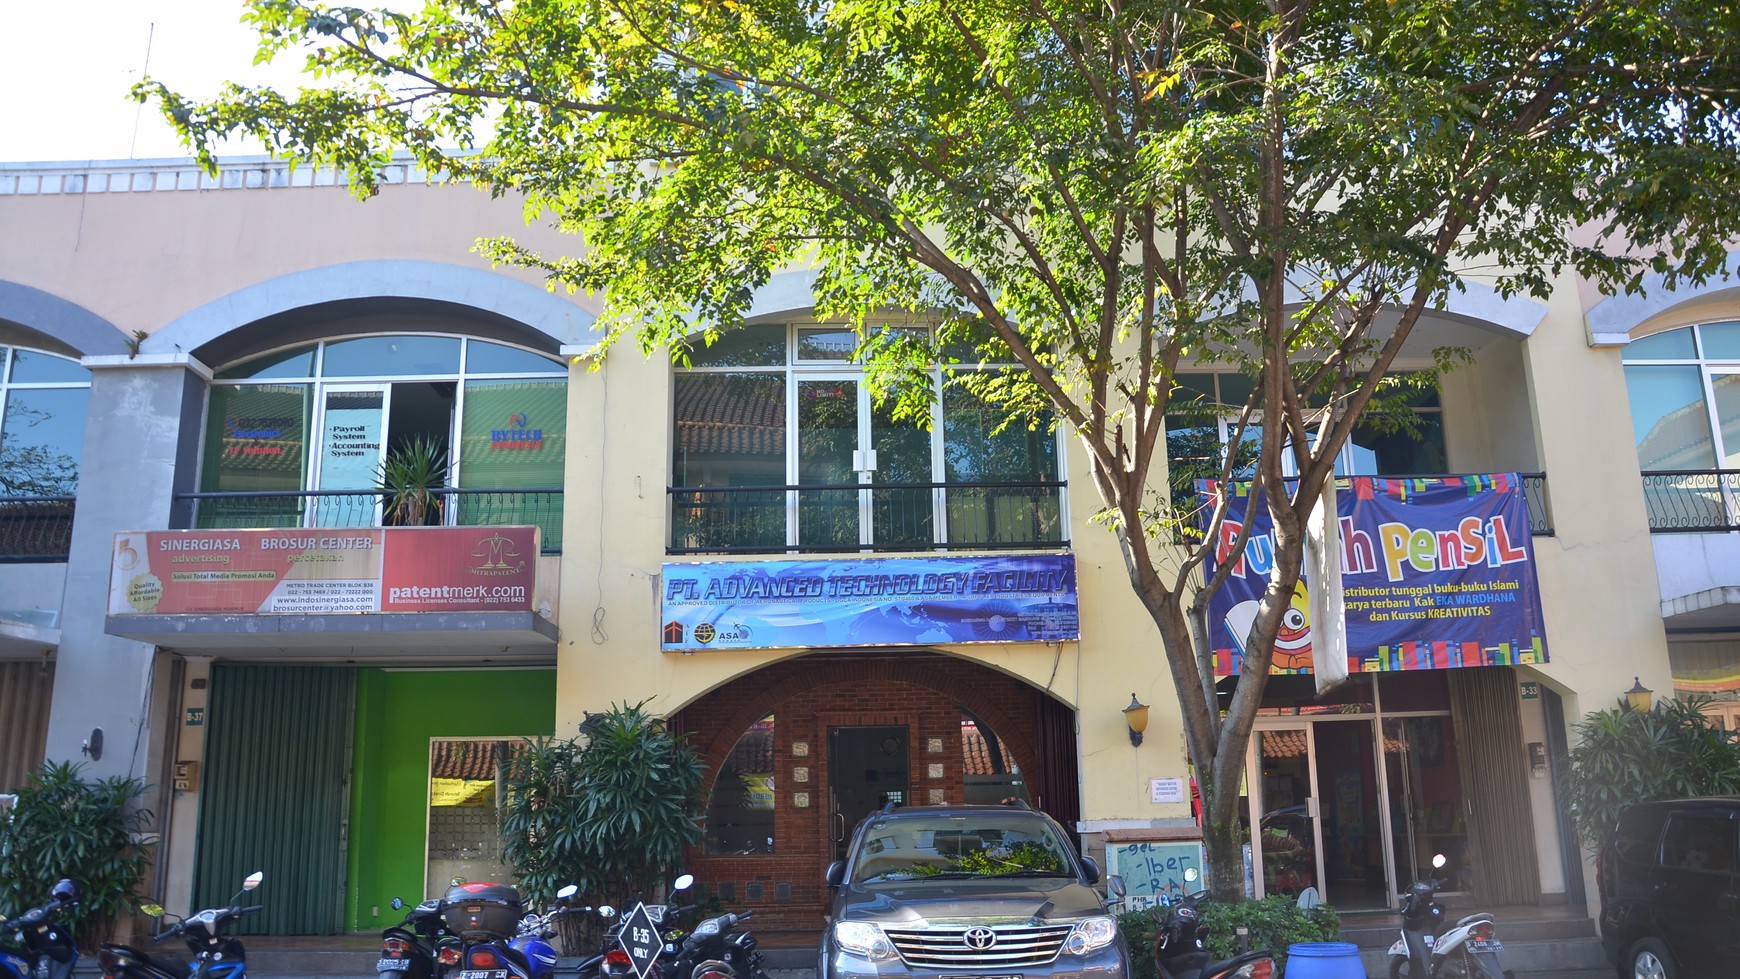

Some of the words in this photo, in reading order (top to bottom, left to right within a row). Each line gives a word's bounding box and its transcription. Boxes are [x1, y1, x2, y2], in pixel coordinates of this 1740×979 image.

[333, 425, 365, 433] Payroll
[331, 442, 380, 450] Accounting
[160, 539, 241, 551] SINERGIASA
[261, 538, 317, 551] BROSUR
[319, 537, 374, 551] CENTER
[1212, 515, 1377, 579] Ruh
[171, 553, 231, 565] advertising
[230, 572, 257, 580] Promosi
[134, 582, 155, 590] Quality
[667, 579, 698, 599] PT.
[704, 576, 823, 598] ADVANCED
[827, 574, 969, 596] TECHNOLOGY
[972, 570, 1068, 593] FACILITY
[1341, 584, 1390, 597] istributor
[1391, 584, 1433, 598] tunggal
[1434, 580, 1487, 594] buku-buku
[1489, 579, 1520, 591] Islami
[276, 596, 373, 604] www.indosinergiasa.com
[389, 585, 525, 603] patentmerk.com
[1371, 598, 1411, 609] terbaru
[1414, 597, 1435, 607] Kak
[1436, 595, 1454, 606] EKA
[1455, 593, 1516, 605] WARDHANA
[1369, 611, 1390, 622] dan
[1391, 610, 1427, 621] Kursus
[1428, 606, 1491, 619] KREATIVITAS
[719, 632, 739, 640] ASA
[1521, 686, 1537, 695] B-33
[187, 712, 203, 721] B-37
[633, 926, 650, 944] B-35
[633, 946, 649, 959] ONLY
[470, 971, 488, 979] 2007
